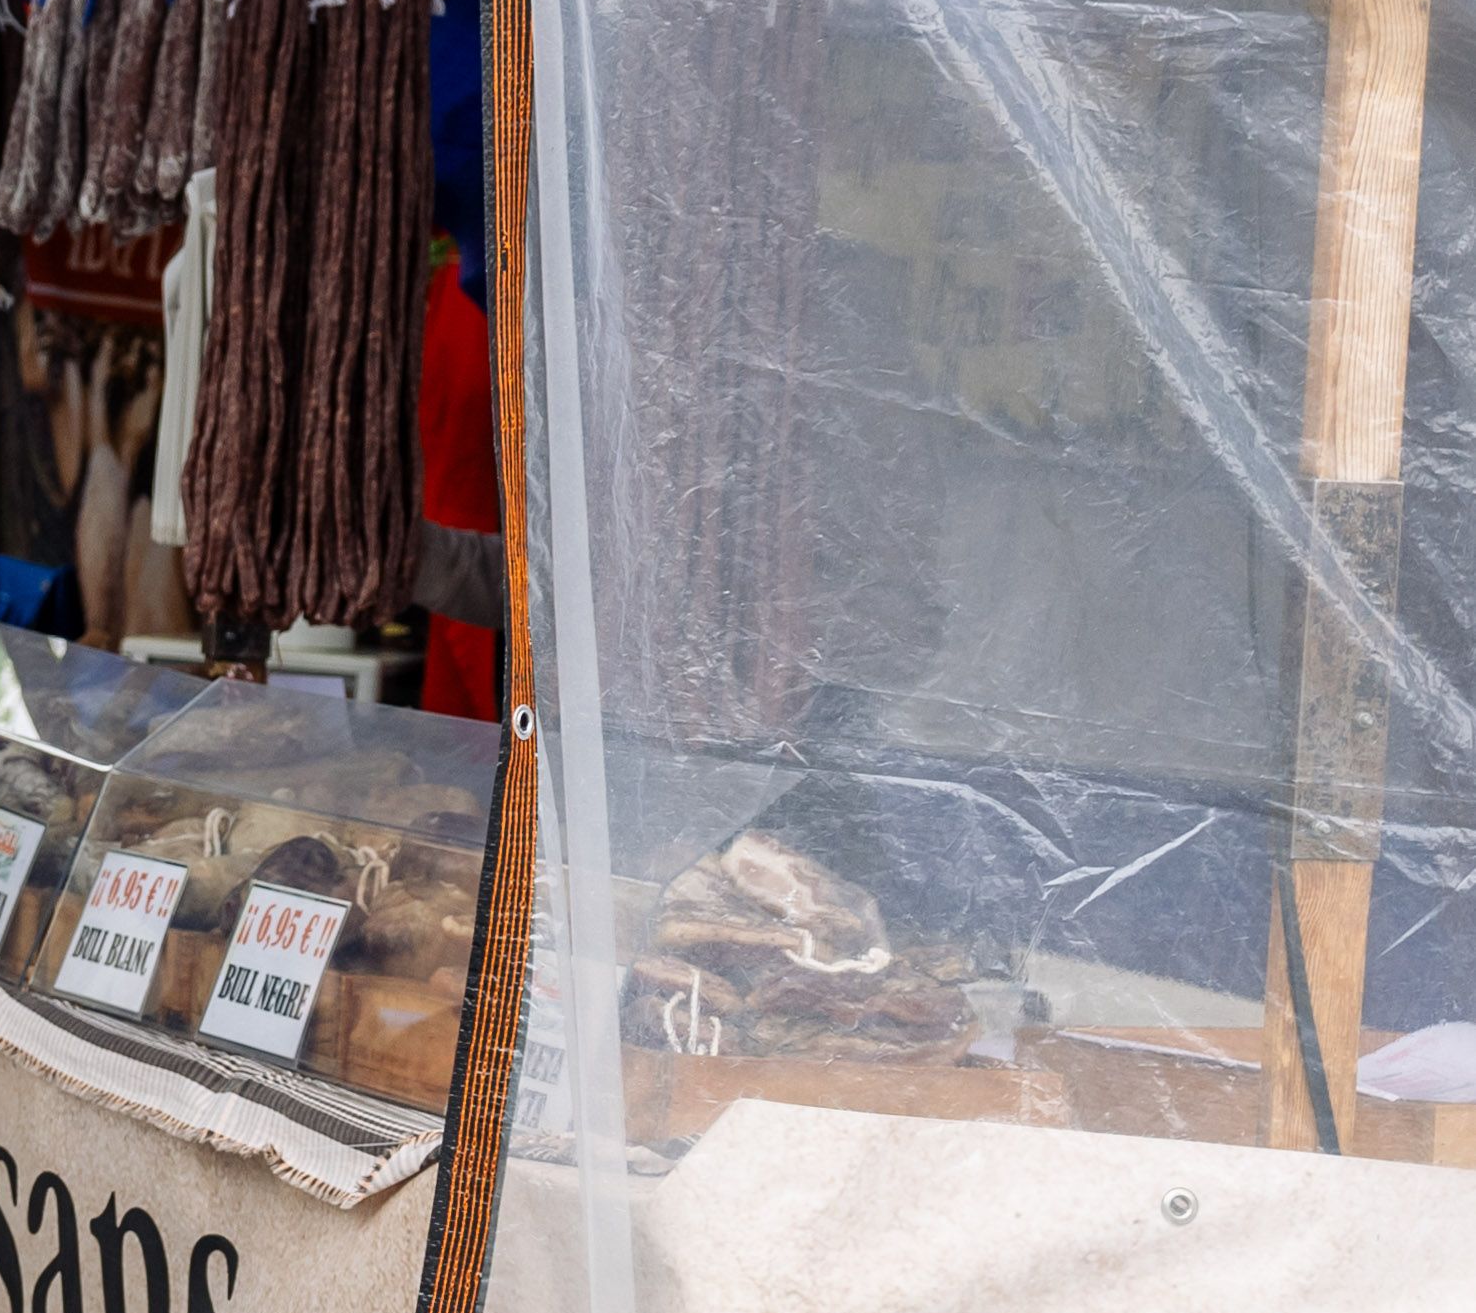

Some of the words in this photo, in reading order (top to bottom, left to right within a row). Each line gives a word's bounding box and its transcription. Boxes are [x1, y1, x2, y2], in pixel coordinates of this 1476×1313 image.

[72, 925, 102, 964] BULL
[104, 932, 155, 976] BLANC
[218, 963, 260, 1007] BULL
[259, 974, 311, 1021] NEGRE
